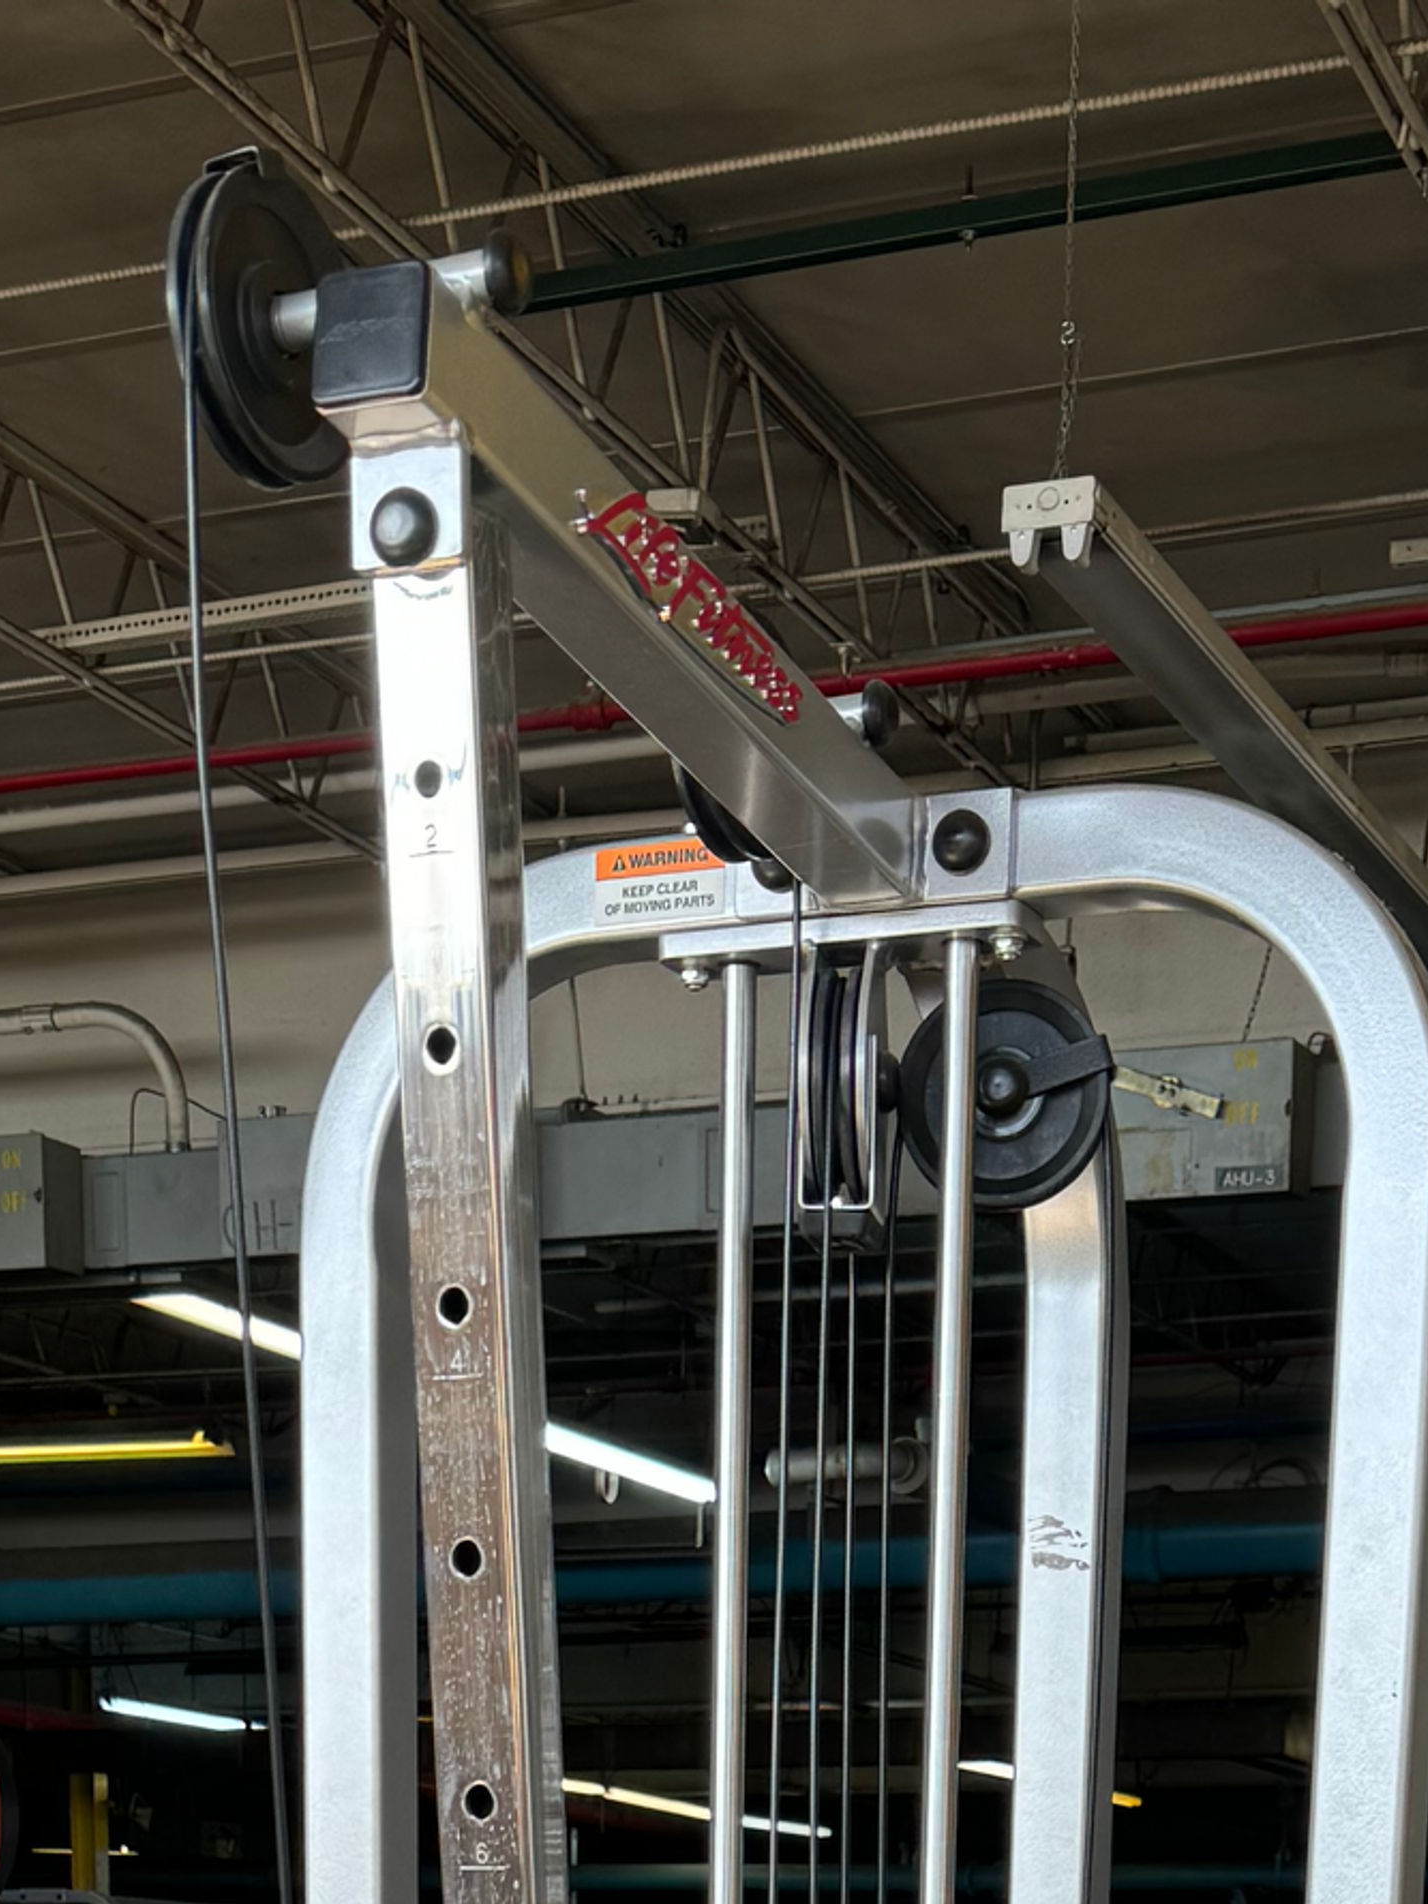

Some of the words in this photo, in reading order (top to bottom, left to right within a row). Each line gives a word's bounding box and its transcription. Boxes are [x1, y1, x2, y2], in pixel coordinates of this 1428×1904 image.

[425, 824, 438, 849] 2
[628, 848, 709, 870] WARNING
[621, 882, 654, 898] KEEP
[657, 879, 699, 896] CLEAR
[604, 900, 622, 916] OF
[623, 897, 671, 914] MOVING
[674, 893, 715, 911] PARTS
[1225, 1101, 1259, 1126] OFF
[1222, 1169, 1276, 1188] AHU-3
[449, 1349, 465, 1372] 4
[474, 1843, 489, 1865] 6
